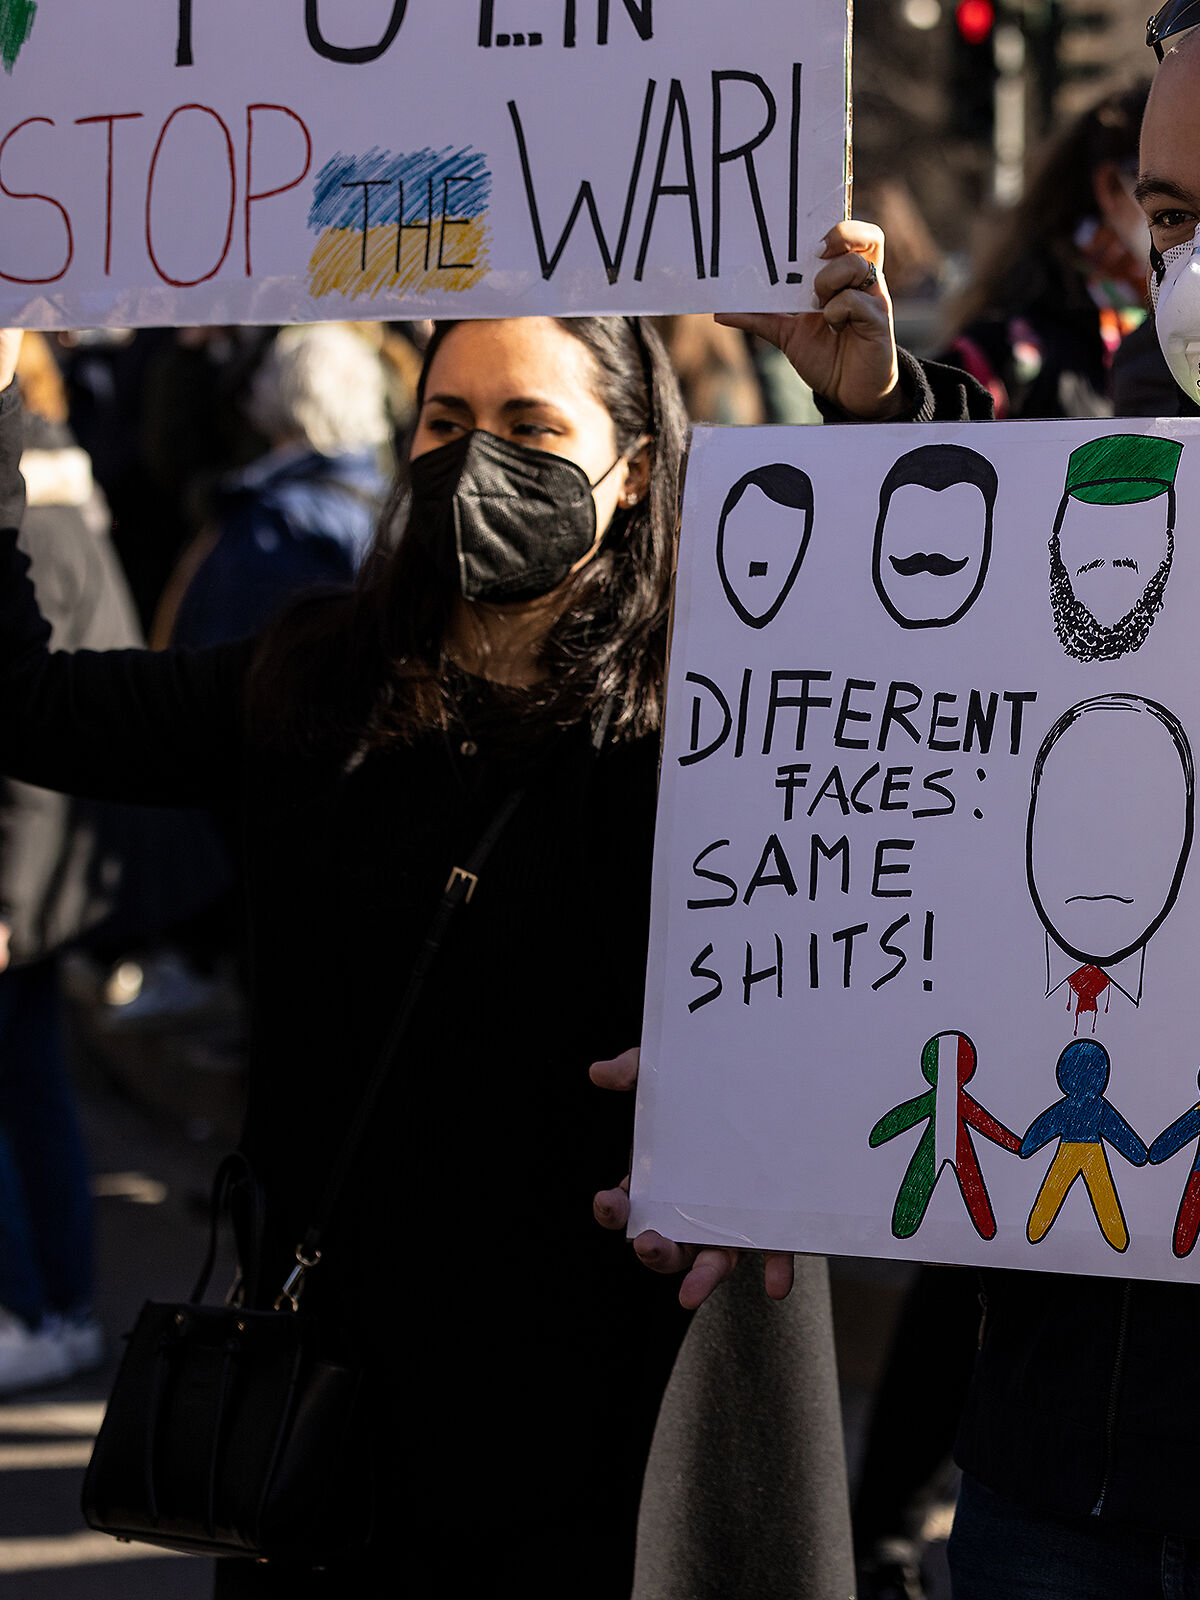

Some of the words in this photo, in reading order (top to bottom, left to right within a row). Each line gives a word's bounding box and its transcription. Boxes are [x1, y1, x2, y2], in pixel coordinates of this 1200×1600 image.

[0, 103, 312, 287] STOP
[341, 177, 476, 273] THE
[508, 63, 803, 286] WAR!
[678, 668, 1038, 766] DIFFERENT
[775, 762, 987, 821] FACES:
[687, 834, 915, 909] SAME
[688, 910, 934, 1014] SHITS!
